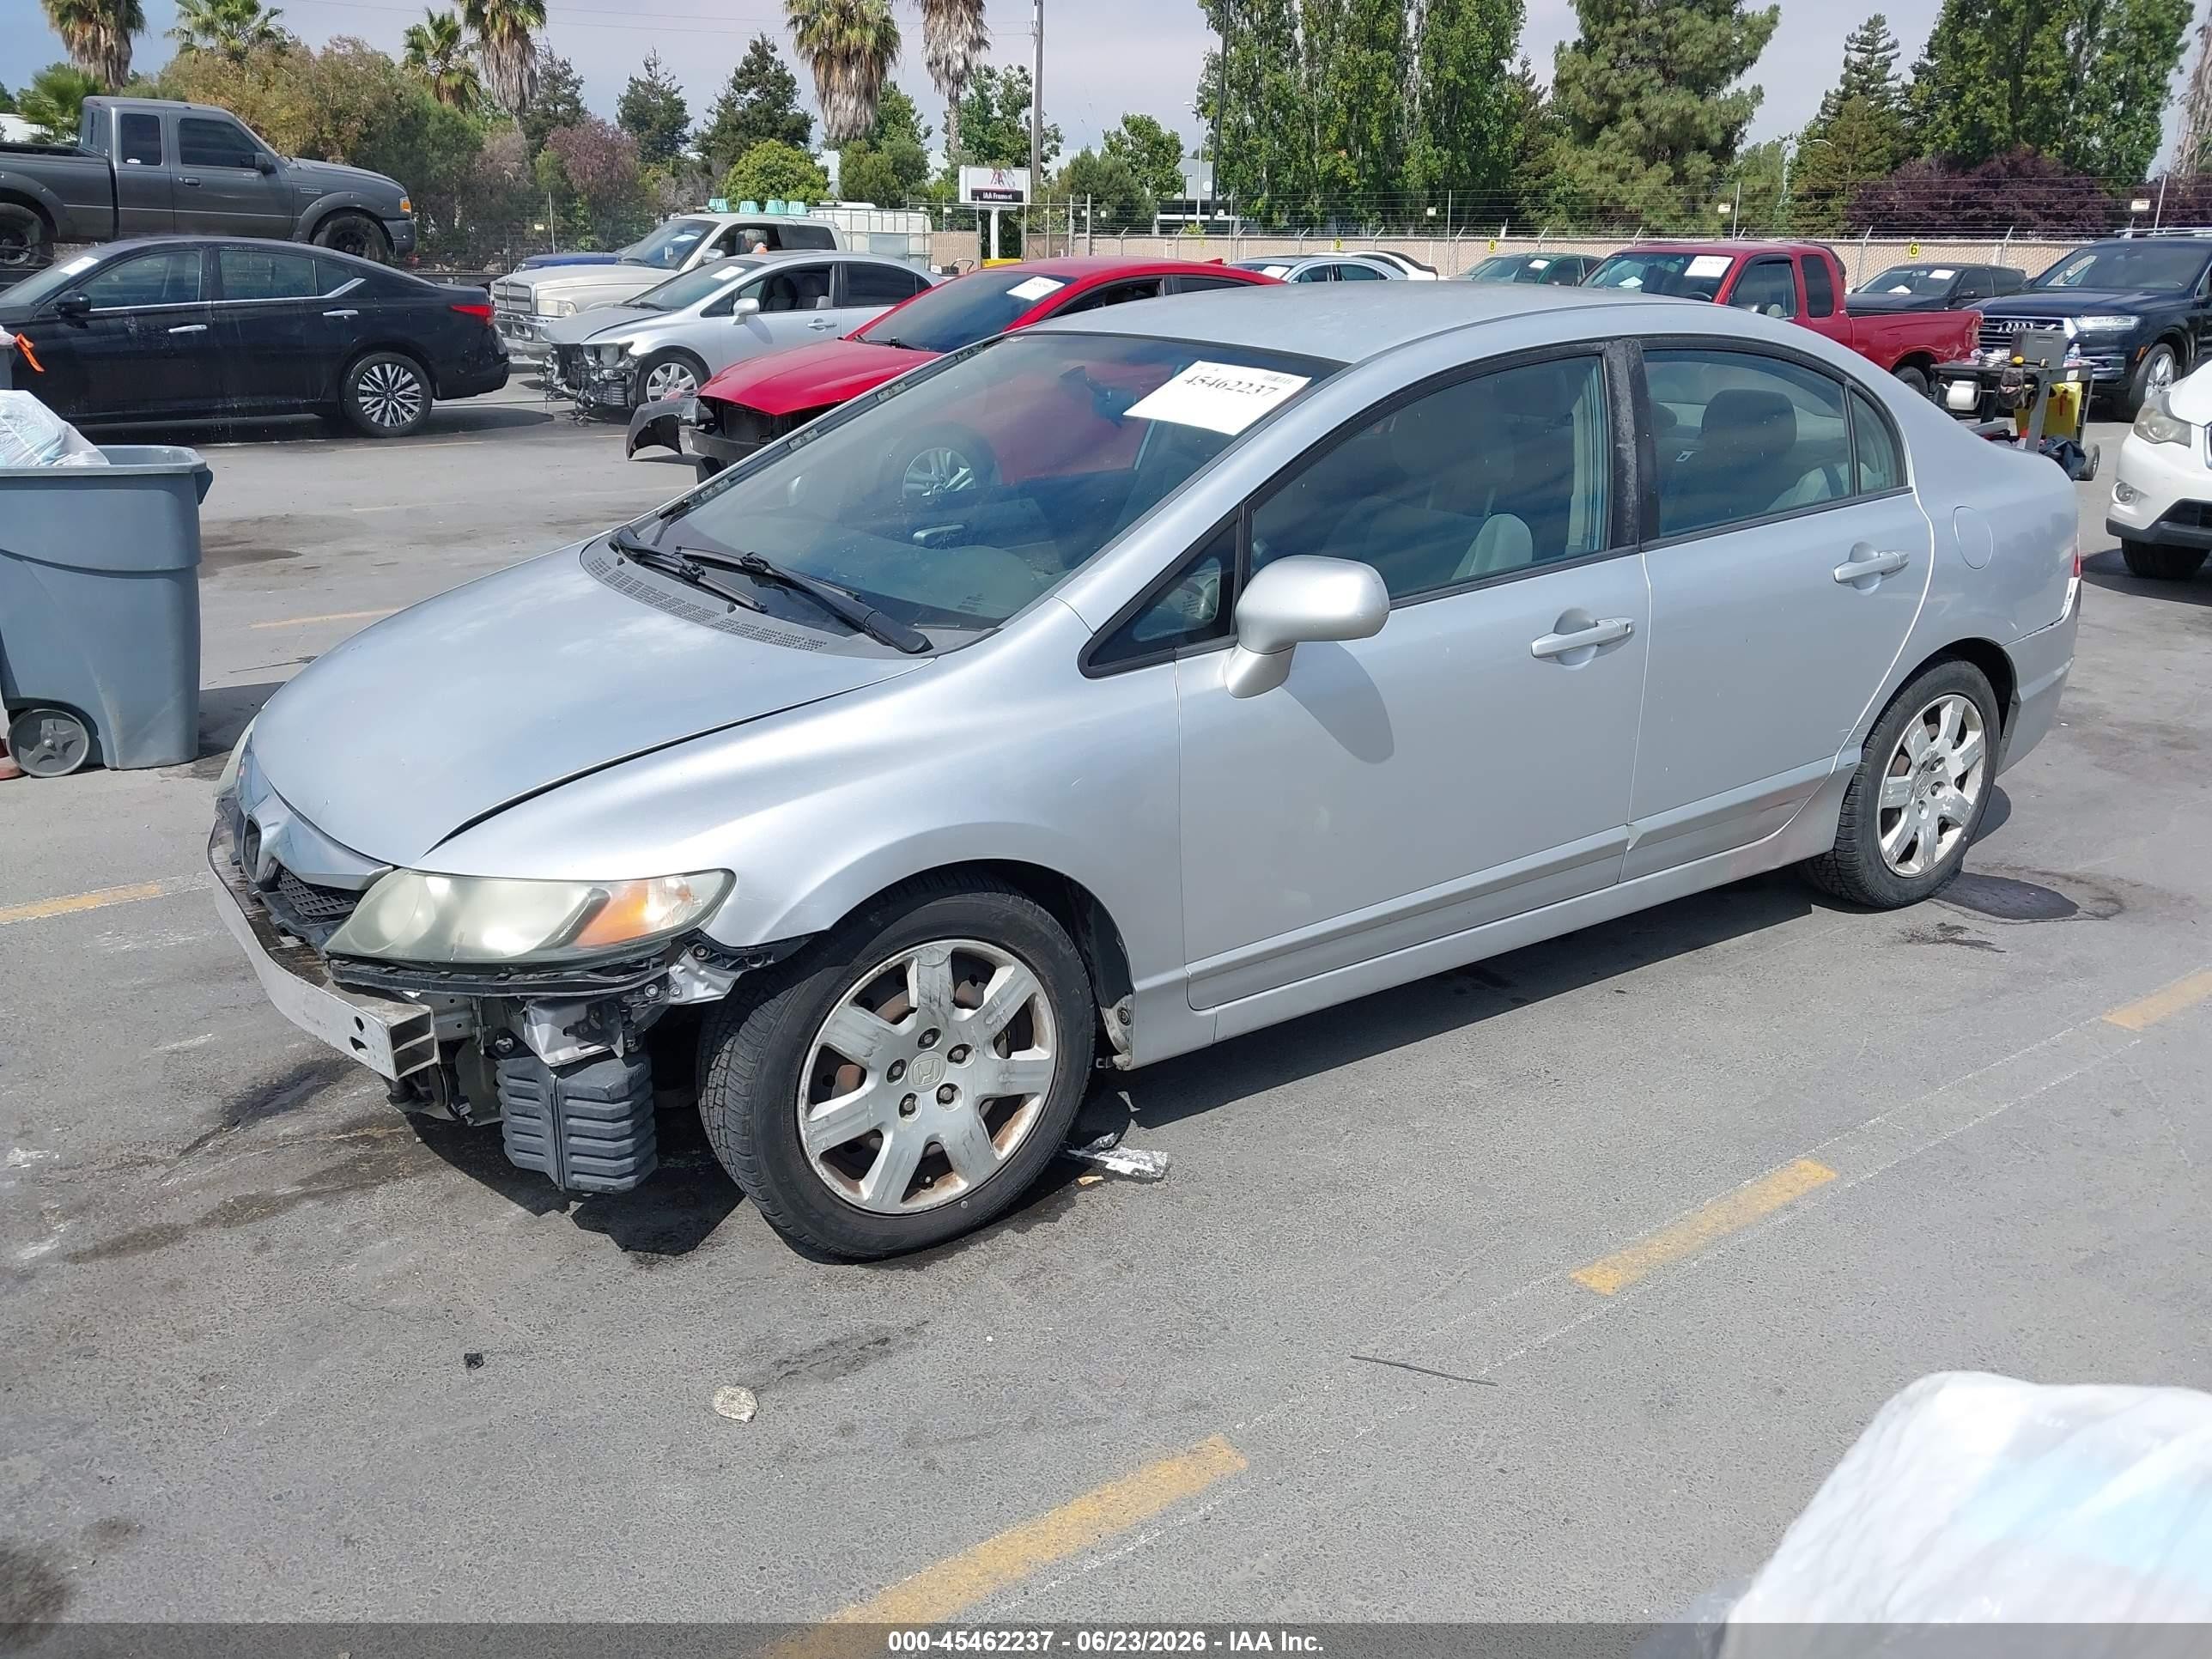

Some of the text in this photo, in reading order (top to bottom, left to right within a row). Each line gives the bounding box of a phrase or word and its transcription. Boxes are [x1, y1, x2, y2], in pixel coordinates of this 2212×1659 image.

[1490, 240, 1495, 251] 8
[1911, 243, 1918, 255] 6
[1183, 374, 1280, 397] 45462237
